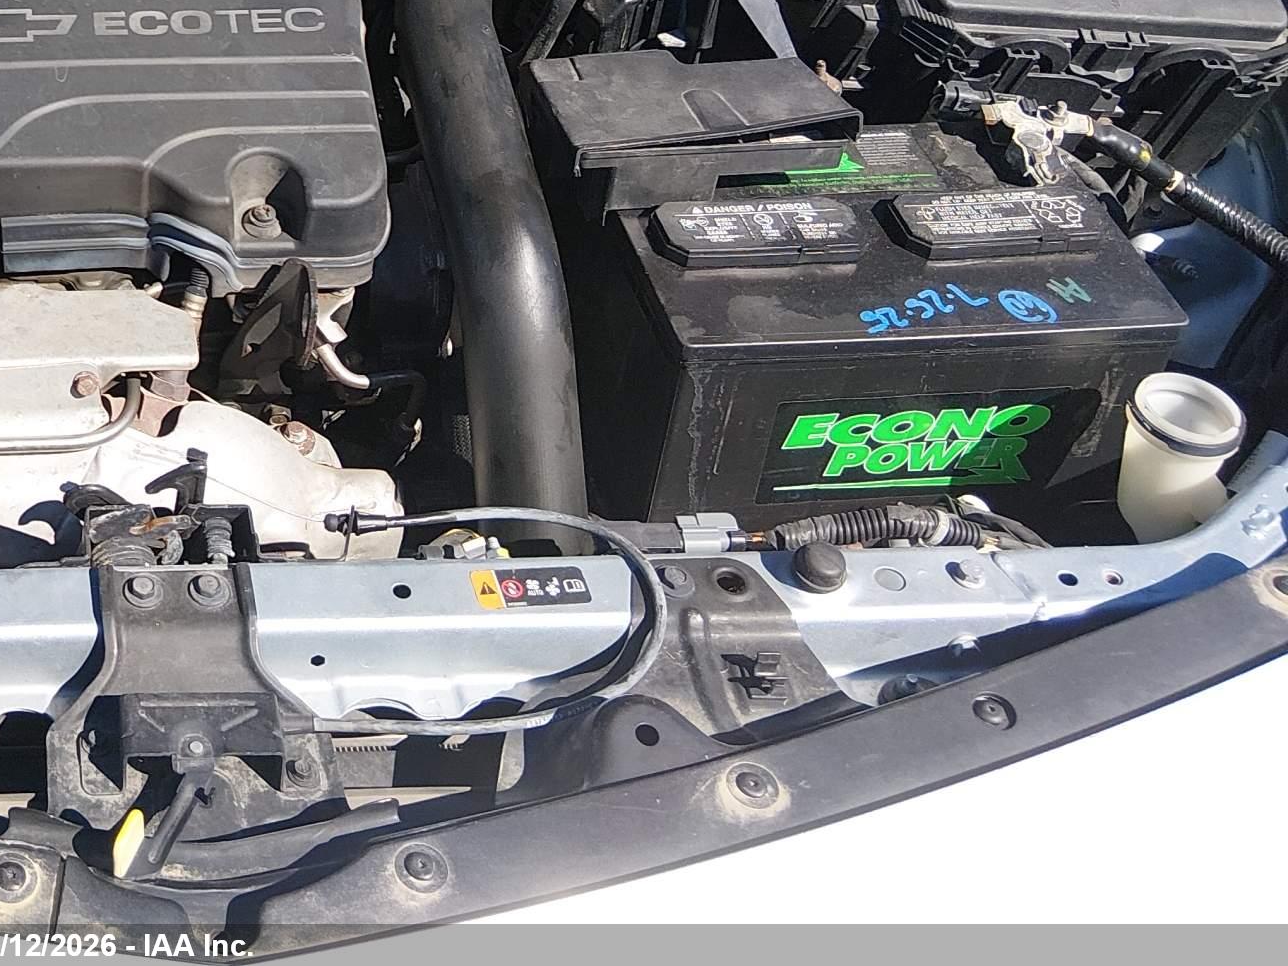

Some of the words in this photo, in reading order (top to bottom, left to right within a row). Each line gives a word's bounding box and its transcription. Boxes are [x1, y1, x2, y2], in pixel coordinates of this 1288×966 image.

[93, 7, 327, 36] ECOTEC
[704, 204, 756, 213] DANGER
[766, 202, 814, 211] POISON
[781, 404, 1052, 450] ECONO
[823, 437, 1032, 481] POWER
